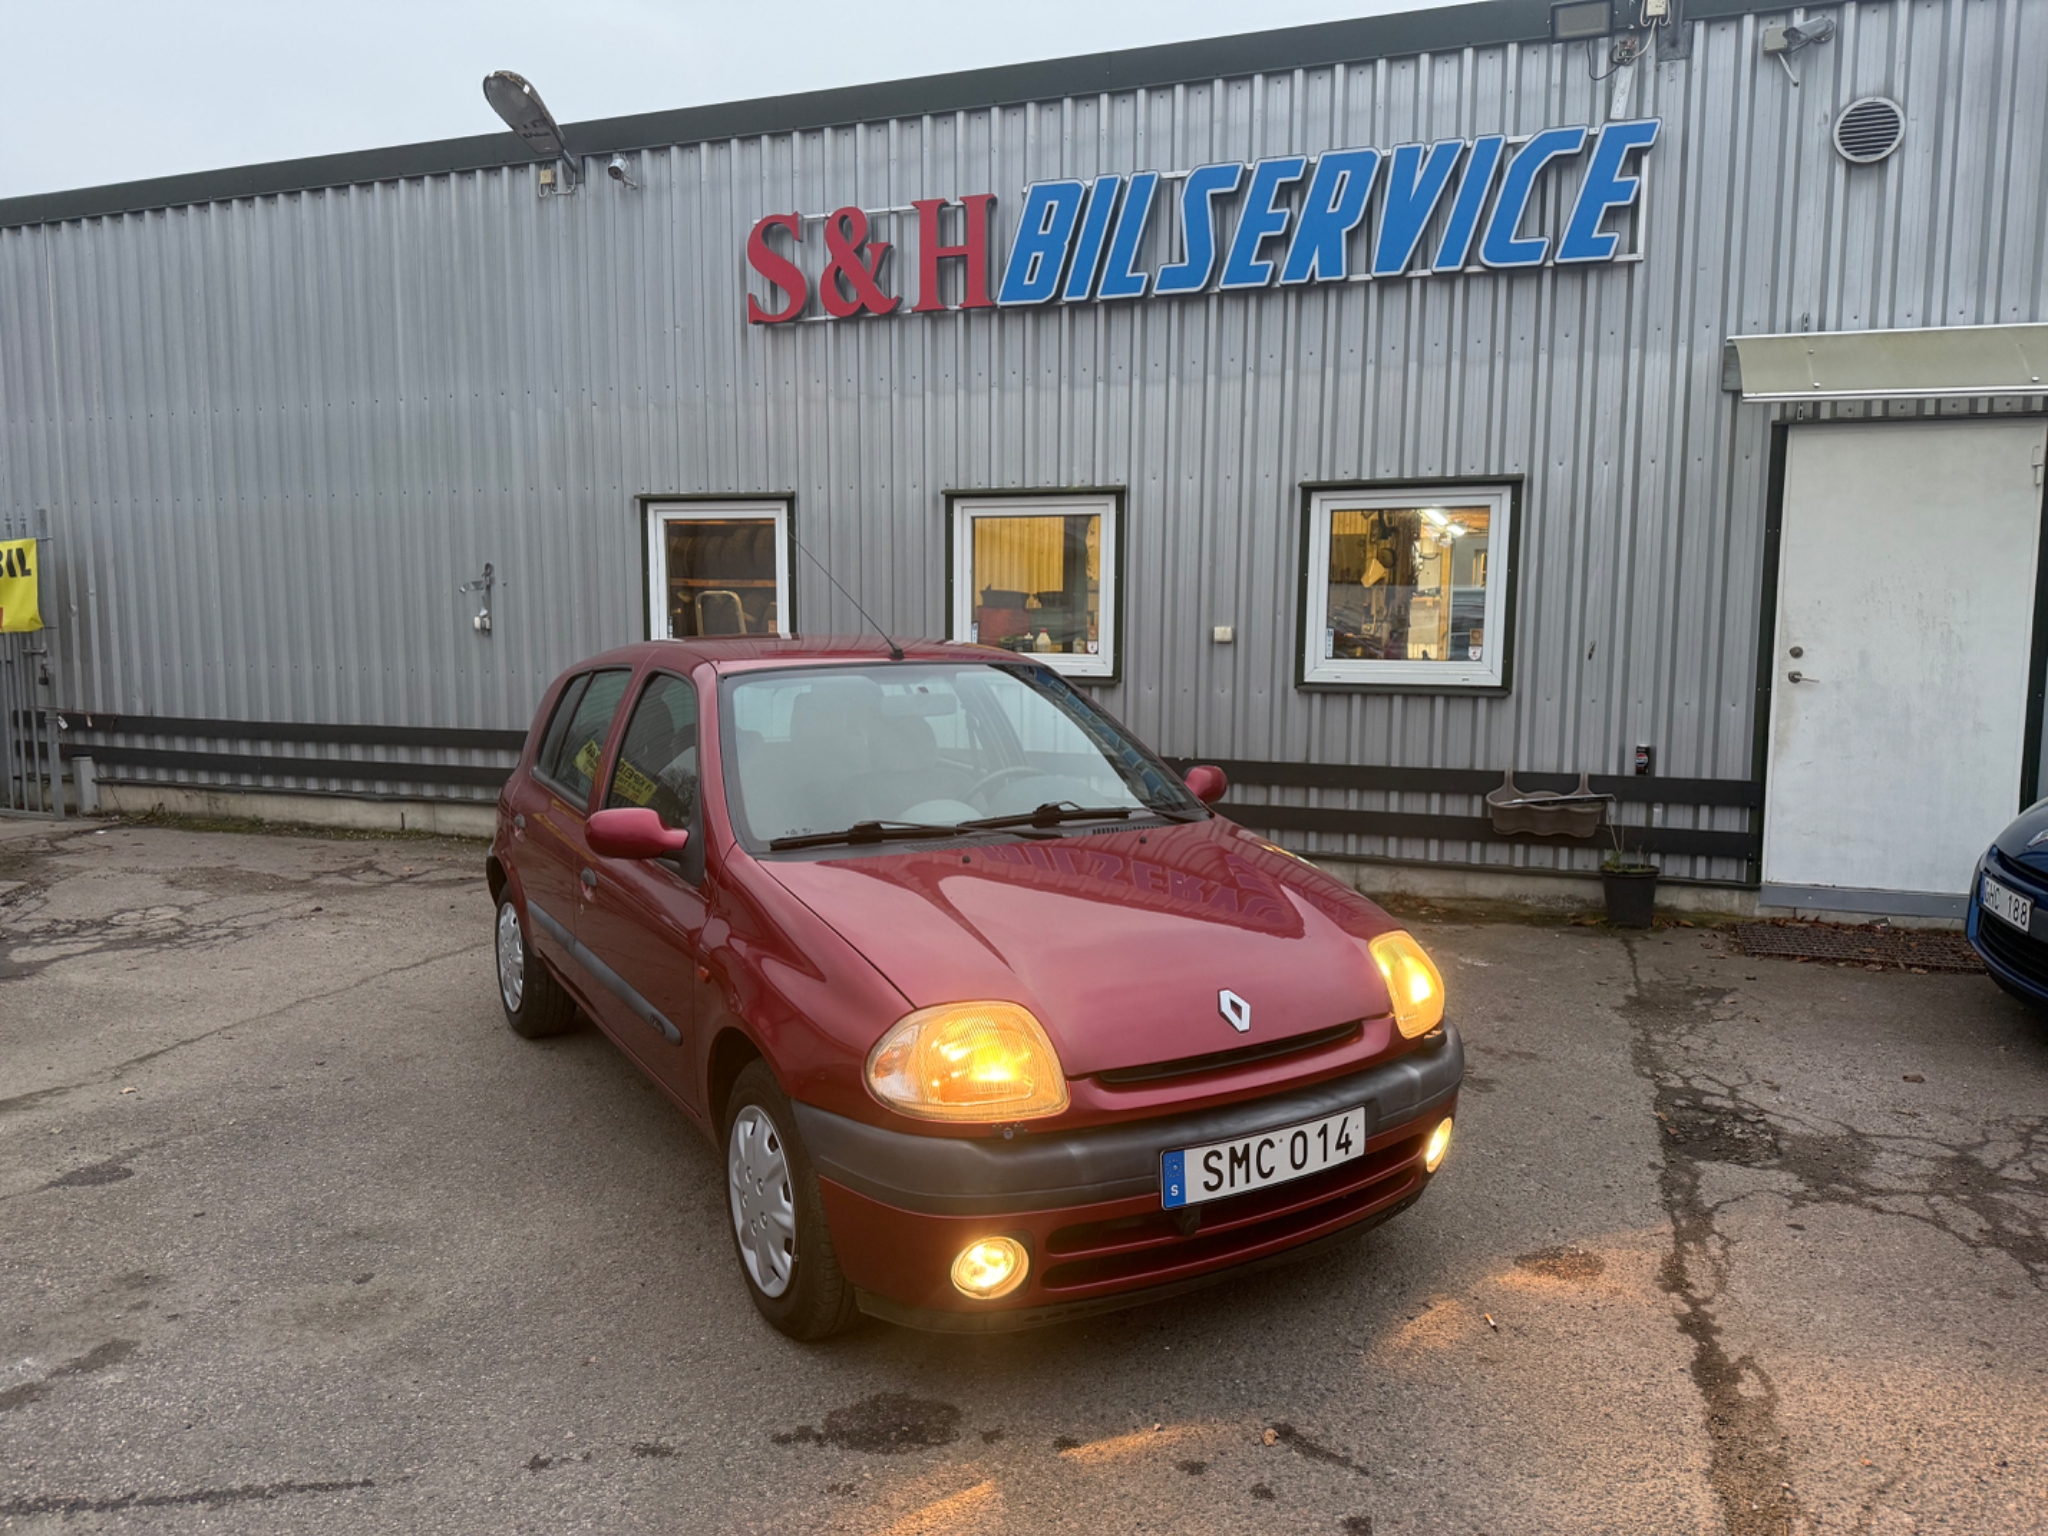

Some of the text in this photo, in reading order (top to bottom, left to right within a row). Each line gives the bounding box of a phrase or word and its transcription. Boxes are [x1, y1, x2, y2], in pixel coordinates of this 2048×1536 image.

[747, 117, 1661, 324] S&H BILSERVICE
[2008, 894, 2027, 926] 188
[1202, 1116, 1353, 1192] SMC 014
[1170, 1184, 1180, 1197] S
